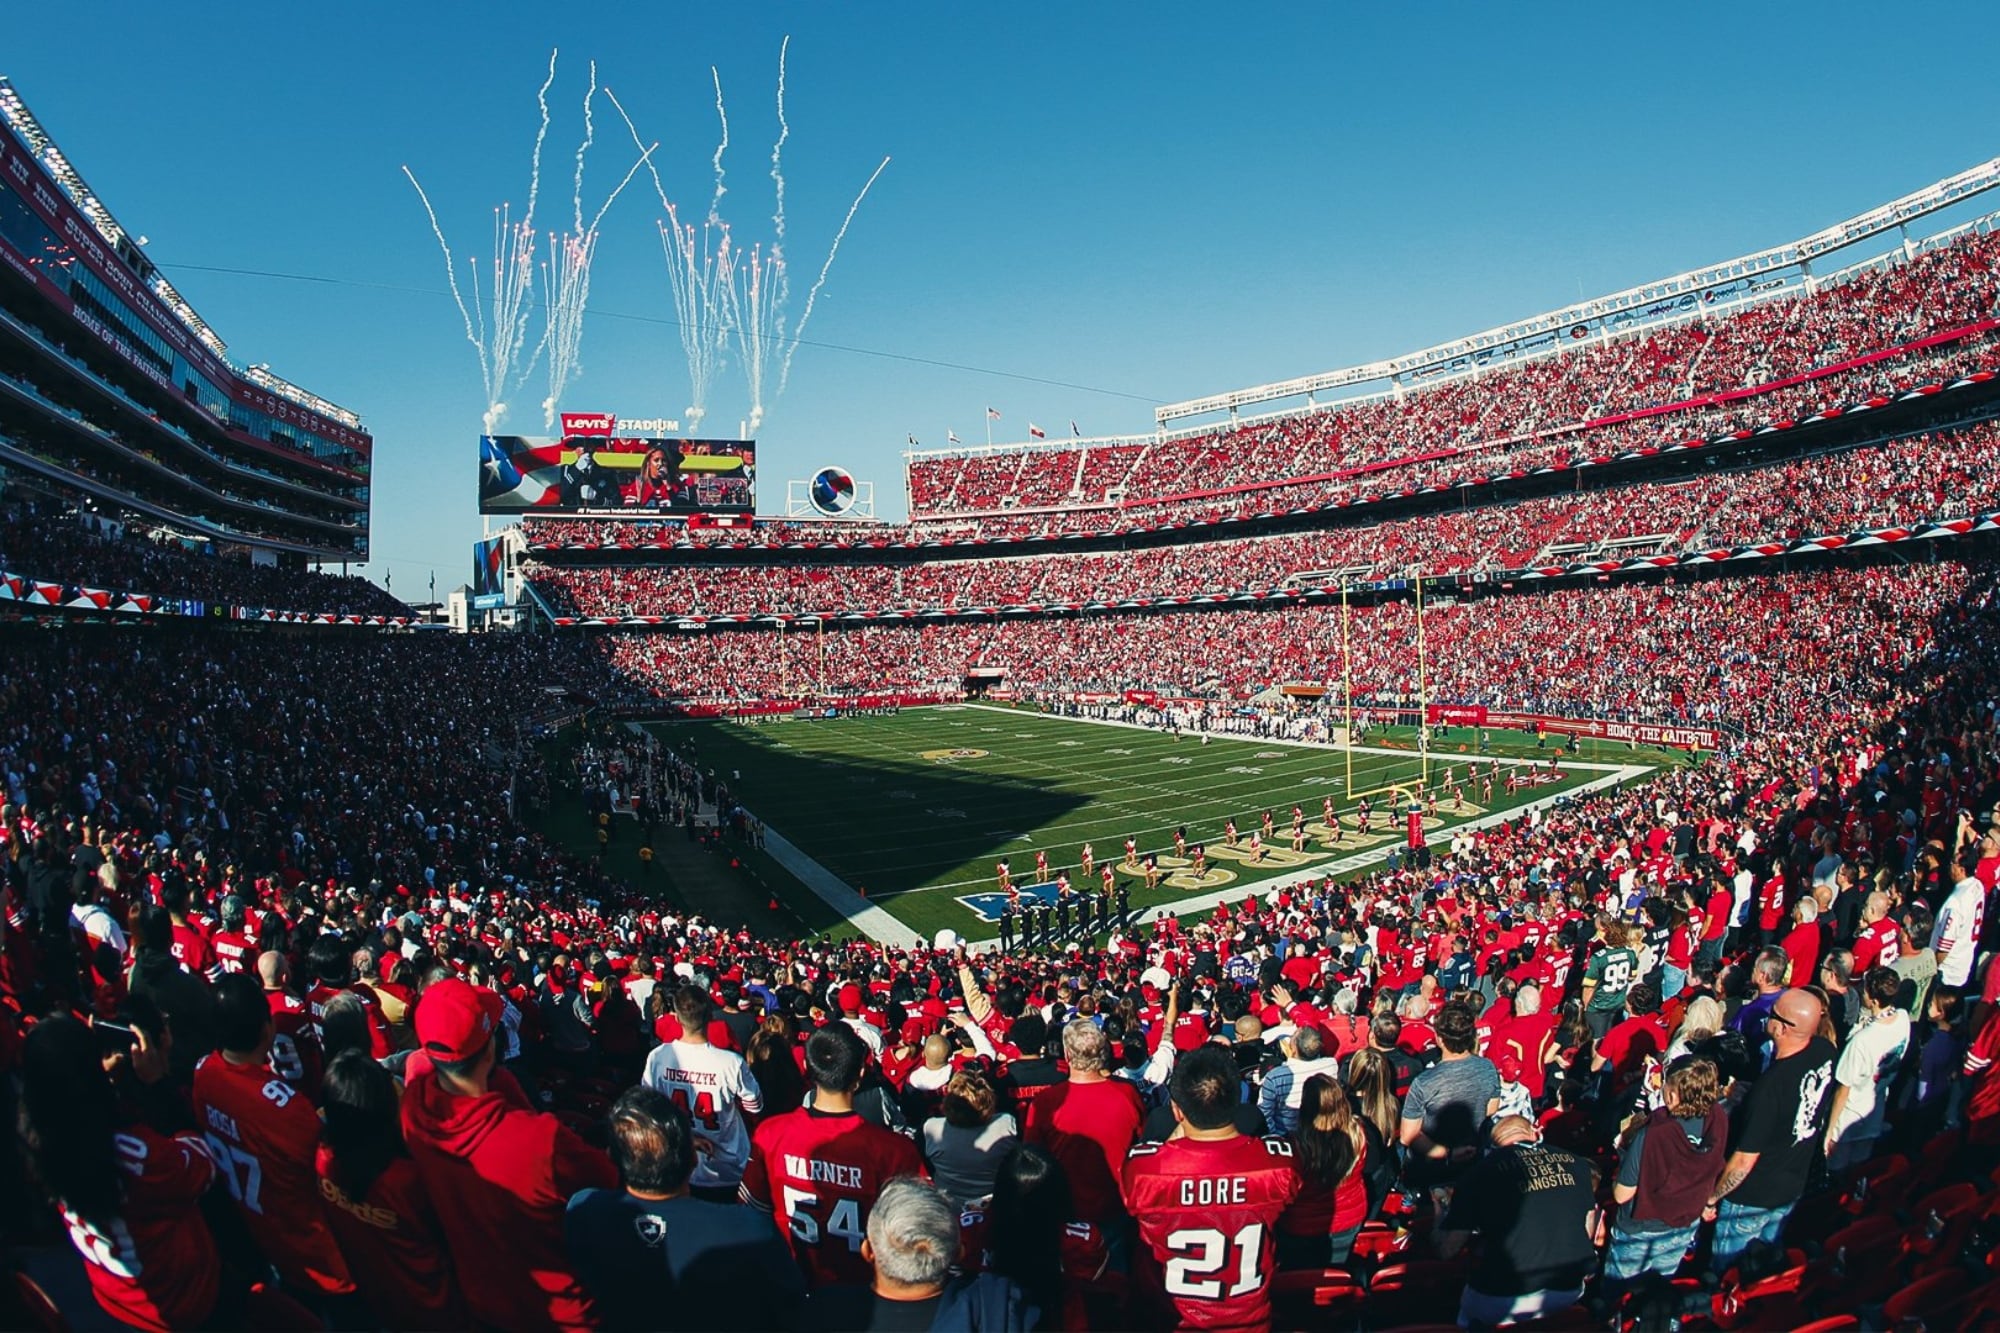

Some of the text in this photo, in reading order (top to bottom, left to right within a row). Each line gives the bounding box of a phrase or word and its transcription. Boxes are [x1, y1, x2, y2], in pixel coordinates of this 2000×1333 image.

[65, 217, 104, 268] SUPER
[104, 261, 135, 299] BOWL
[72, 304, 100, 336] HOME
[114, 341, 133, 361] THE
[132, 354, 169, 390] FAITHFUL
[617, 418, 680, 432] STADIUM
[1606, 723, 1633, 739] HOME
[1640, 726, 1660, 741] THE
[1552, 966, 1569, 988] 10
[1603, 962, 1631, 993] 99
[662, 1066, 718, 1087] JUSZCZYK
[783, 1153, 863, 1190] WARNER
[1538, 1163, 1556, 1177] BE
[1556, 1162, 1566, 1174] A
[1545, 1152, 1576, 1165] GOOD
[1180, 1176, 1248, 1207] GORE
[782, 1185, 868, 1253] 54
[1164, 1223, 1265, 1300] 21
